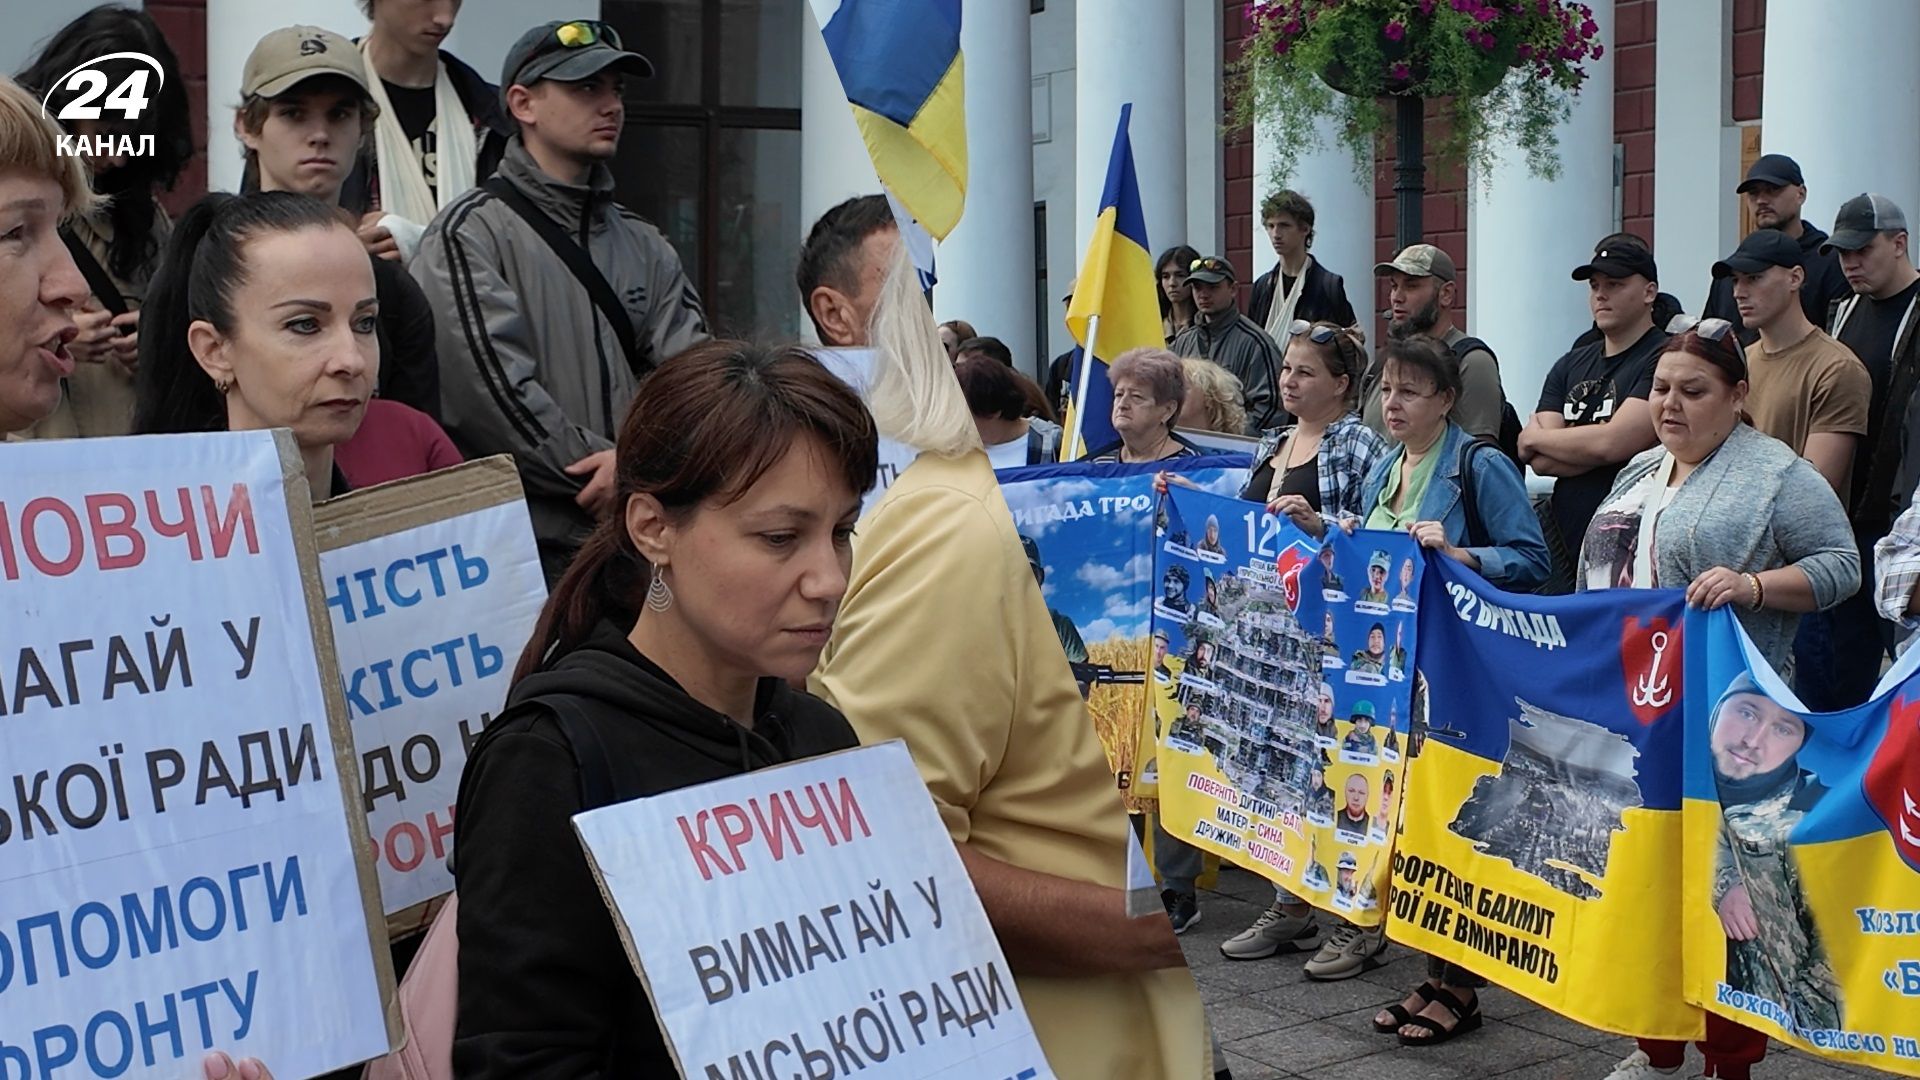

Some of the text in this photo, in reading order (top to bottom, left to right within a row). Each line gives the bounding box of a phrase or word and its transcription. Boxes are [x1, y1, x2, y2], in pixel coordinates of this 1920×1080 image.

[1010, 495, 1153, 527] ИГАДА ТРО
[0, 614, 260, 717] АГАЙ У
[1476, 597, 1567, 650] БРИГАДА
[144, 724, 323, 812] РАДИ
[677, 777, 872, 880] КРИЧИ
[1195, 821, 1241, 849] ДРУЖИНІ
[1217, 807, 1248, 830] МАТЕРІ
[1393, 850, 1555, 940] ФОРТЕЦЯ БАХМУТ
[688, 876, 943, 1006] ВИМАГАЙ У
[1420, 901, 1453, 936] НЕ
[1453, 913, 1559, 984] ВМИРАЮТЬ
[899, 962, 1013, 1046] РАДИ
